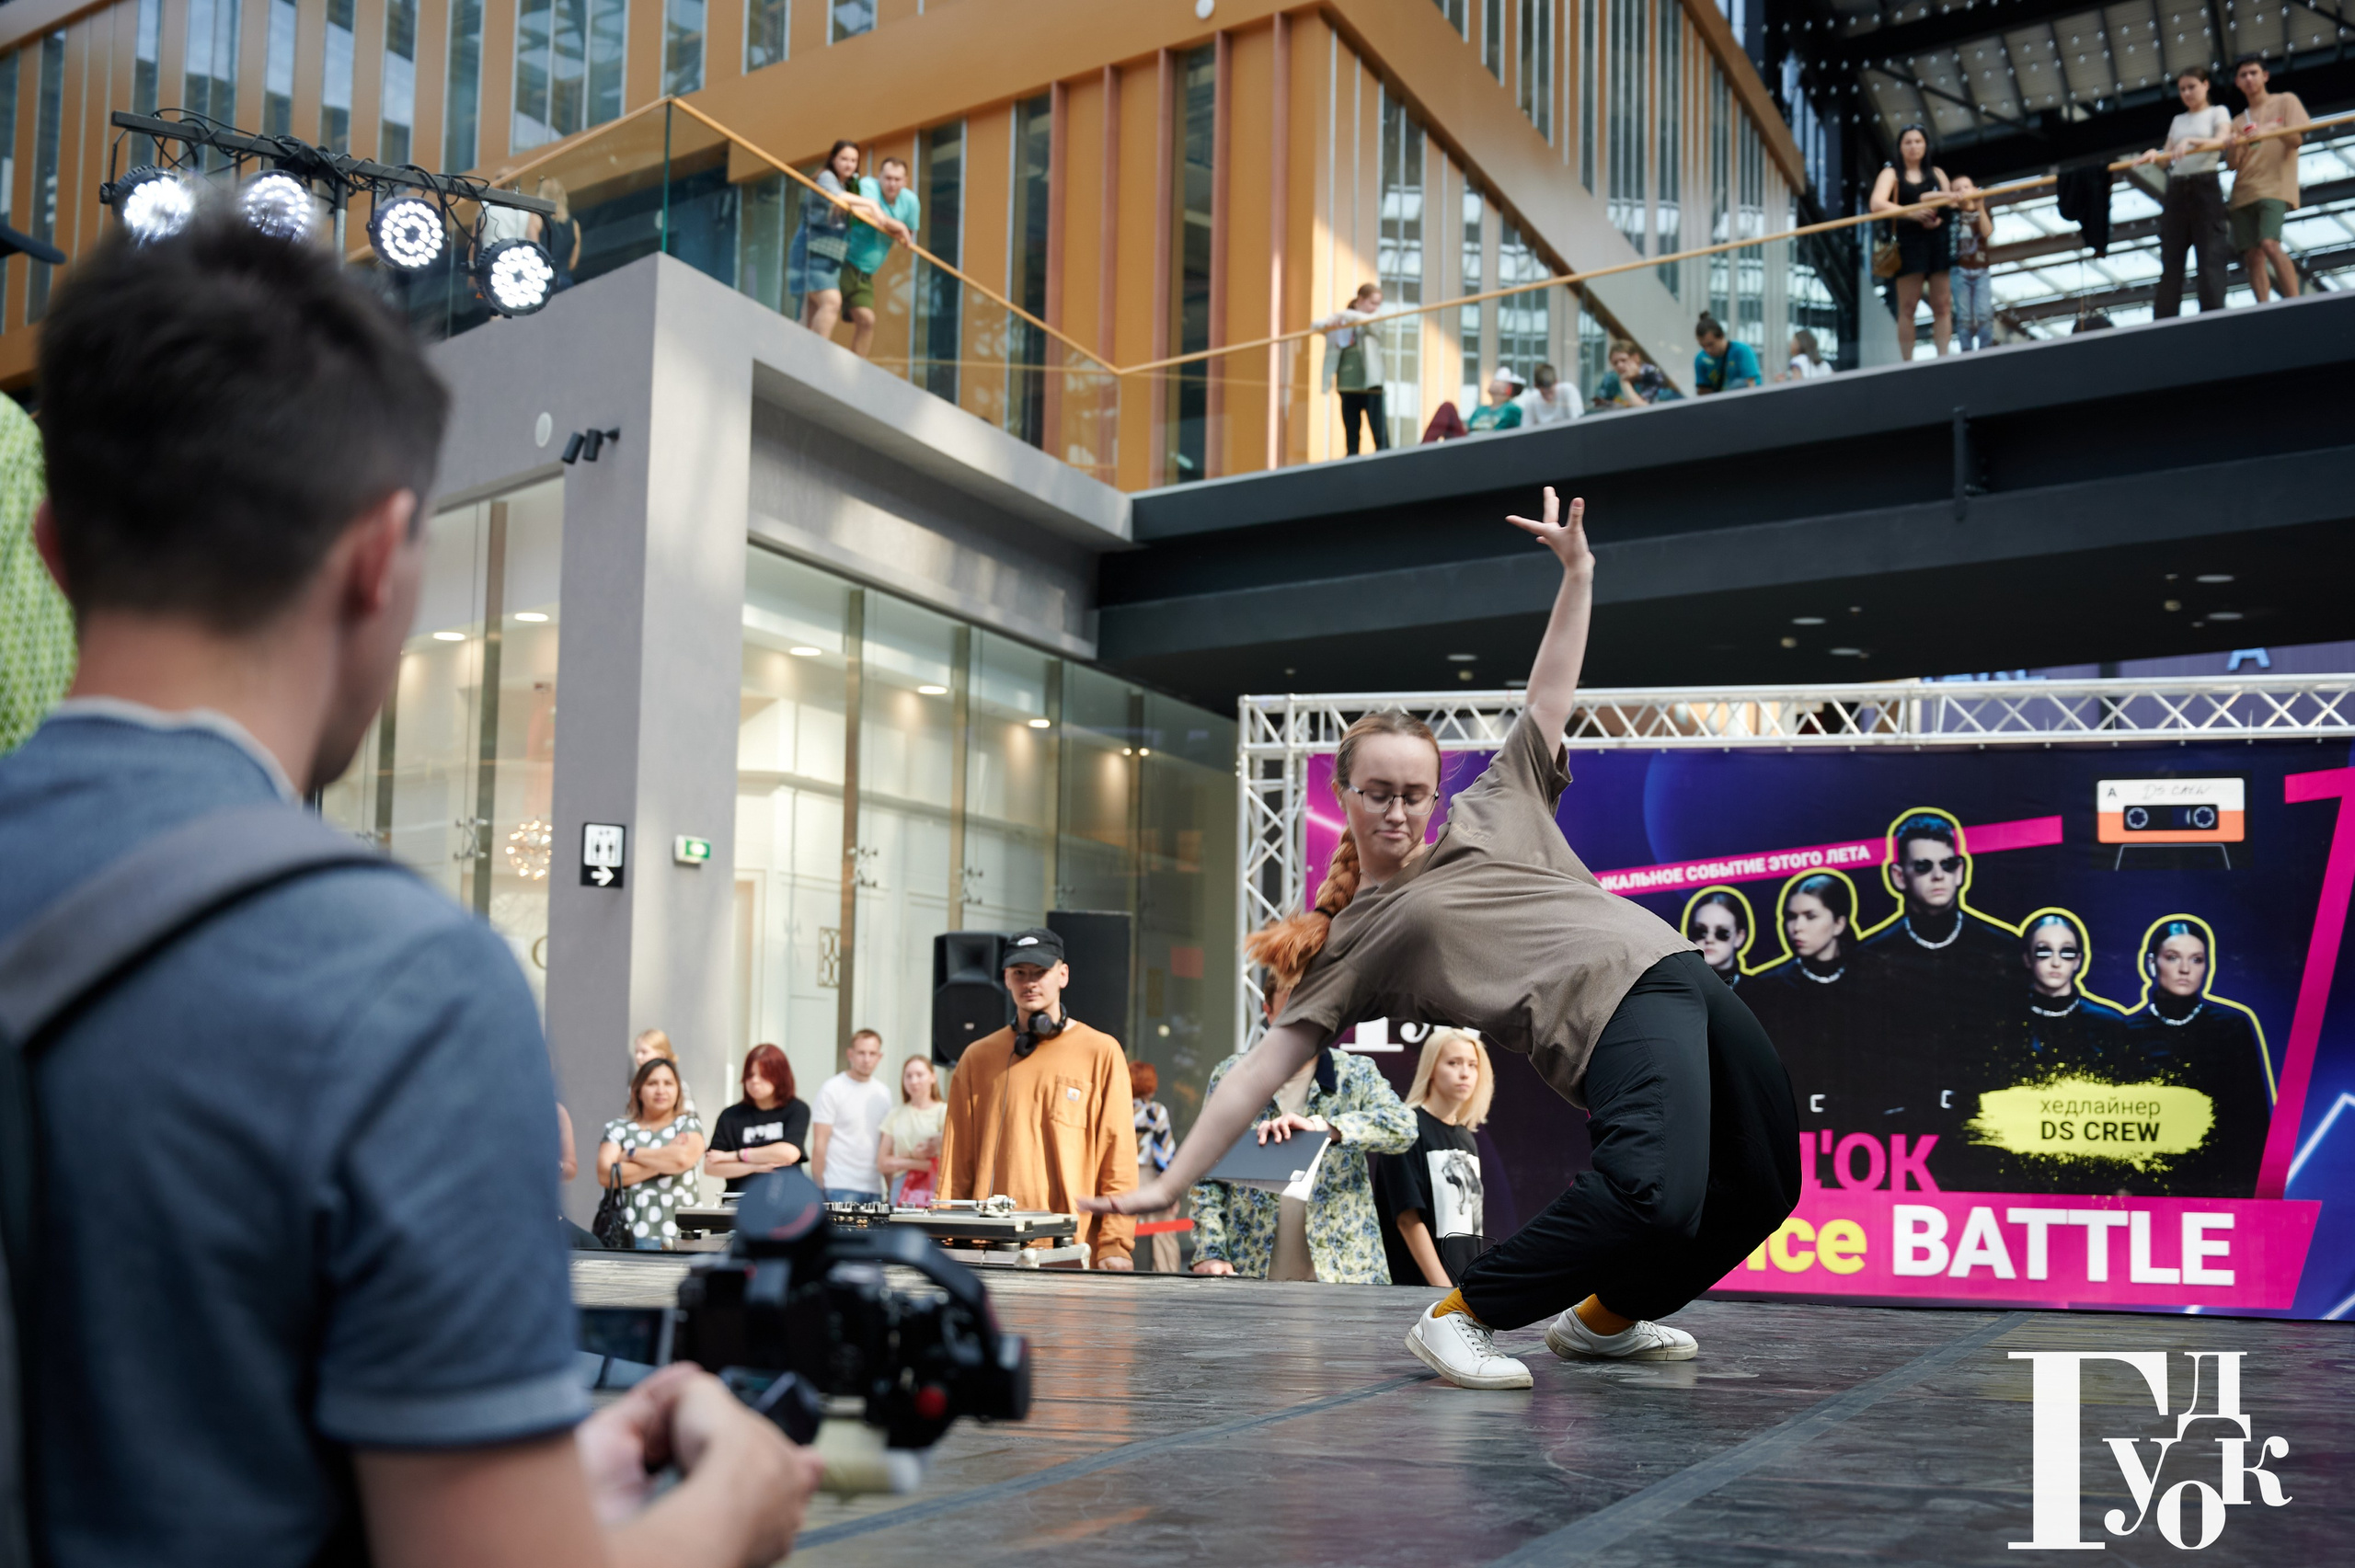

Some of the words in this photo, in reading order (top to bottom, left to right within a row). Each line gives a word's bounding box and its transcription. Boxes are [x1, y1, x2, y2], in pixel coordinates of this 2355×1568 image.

[1685, 856, 1766, 882] СОБЫТИЕ
[1767, 850, 1823, 872] ЭТОГО
[1825, 844, 1871, 864] ЛЕТА
[2039, 1096, 2162, 1120] хедлайнер
[2040, 1120, 2075, 1141] DS
[2084, 1121, 2161, 1142] CREW
[1892, 1204, 2235, 1287] BATTLE
